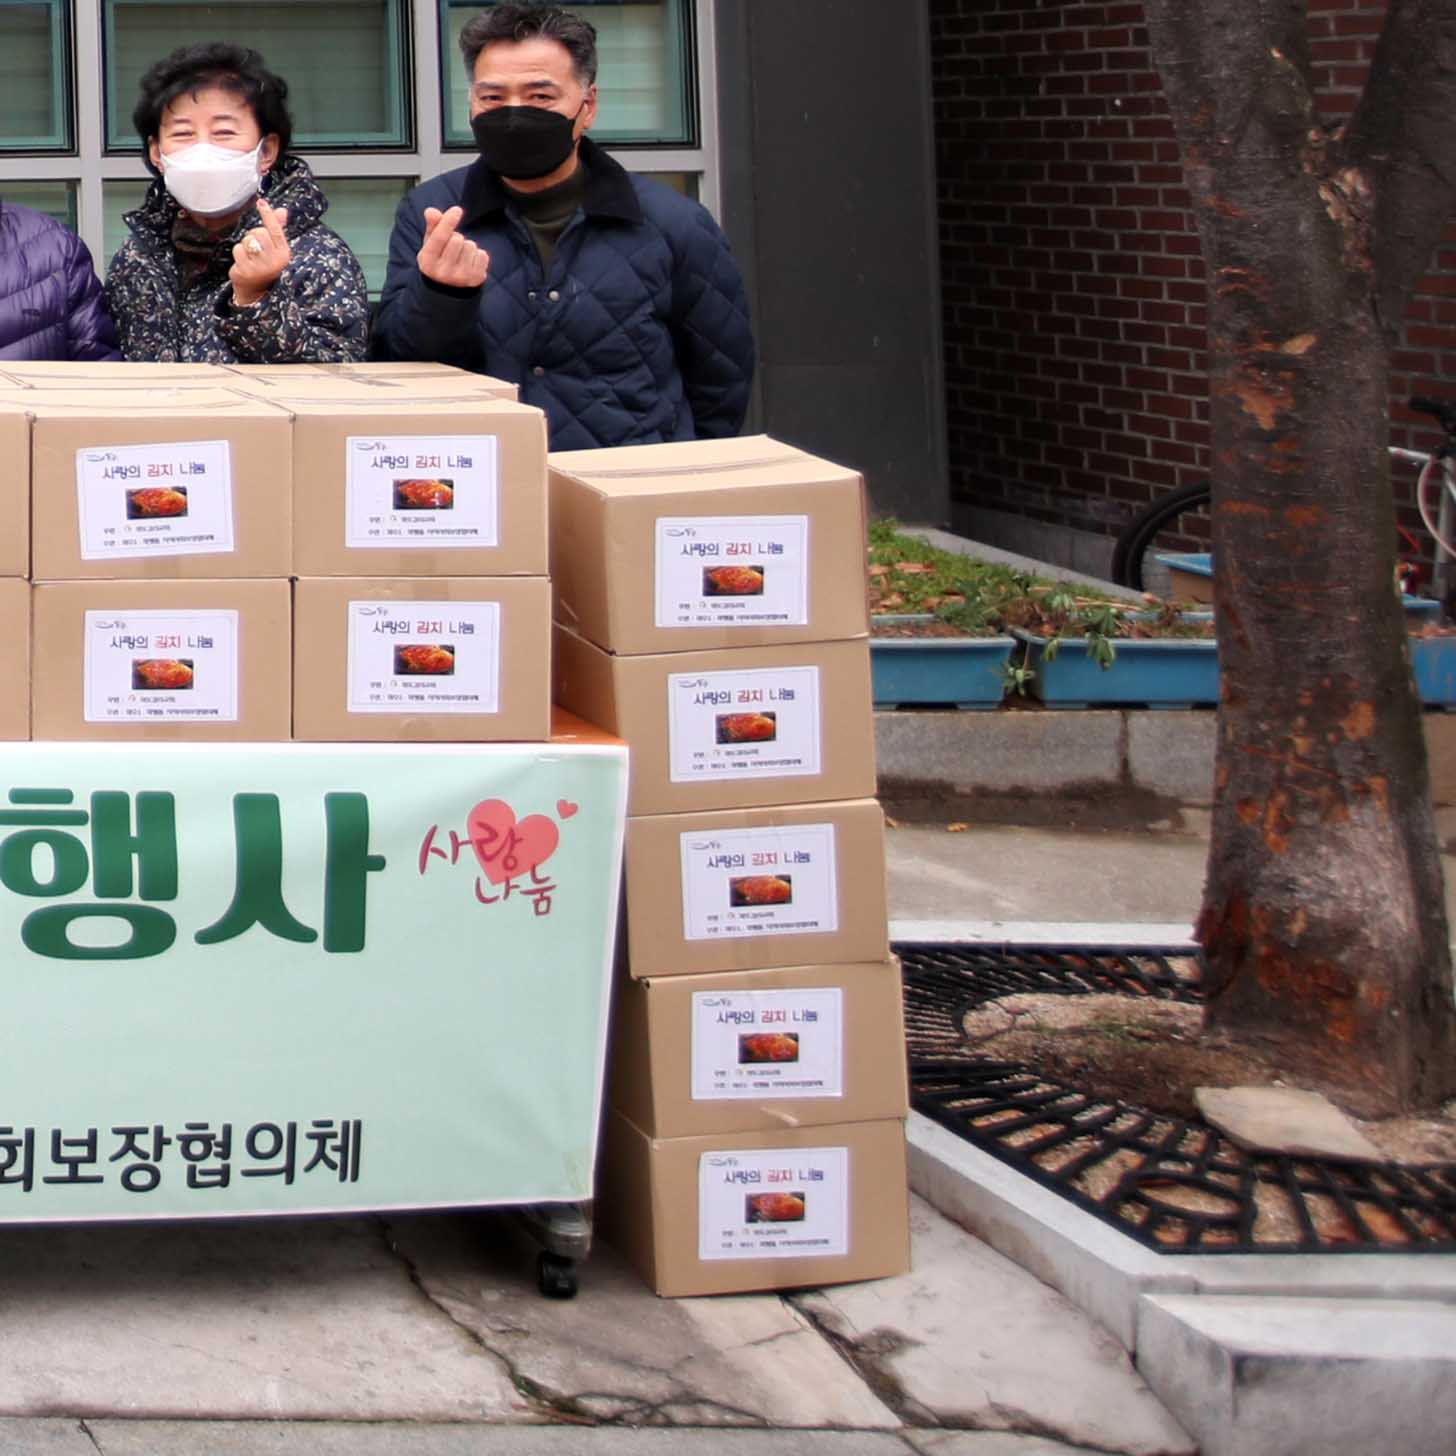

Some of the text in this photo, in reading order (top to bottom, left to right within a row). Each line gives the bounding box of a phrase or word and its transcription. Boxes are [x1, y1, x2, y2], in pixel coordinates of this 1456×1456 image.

[370, 454, 409, 470] 사랑의
[414, 454, 441, 469] 김치
[103, 464, 141, 480] 사랑의
[146, 462, 173, 478] 김치
[680, 542, 720, 557] 사랑의
[725, 542, 752, 556] 김치
[372, 619, 410, 635] 사랑의
[415, 620, 442, 634] 김치
[109, 634, 148, 650] 사랑의
[155, 635, 181, 649] 김치
[693, 690, 732, 705] 사랑의
[737, 688, 763, 703] 김치
[419, 821, 523, 875] 사랑
[707, 853, 745, 869] 사랑의
[752, 851, 778, 866] 김치
[716, 1010, 755, 1025] 사랑의
[761, 1009, 786, 1023] 김치
[724, 1169, 761, 1185] 사랑의
[768, 1169, 792, 1182] 김치
